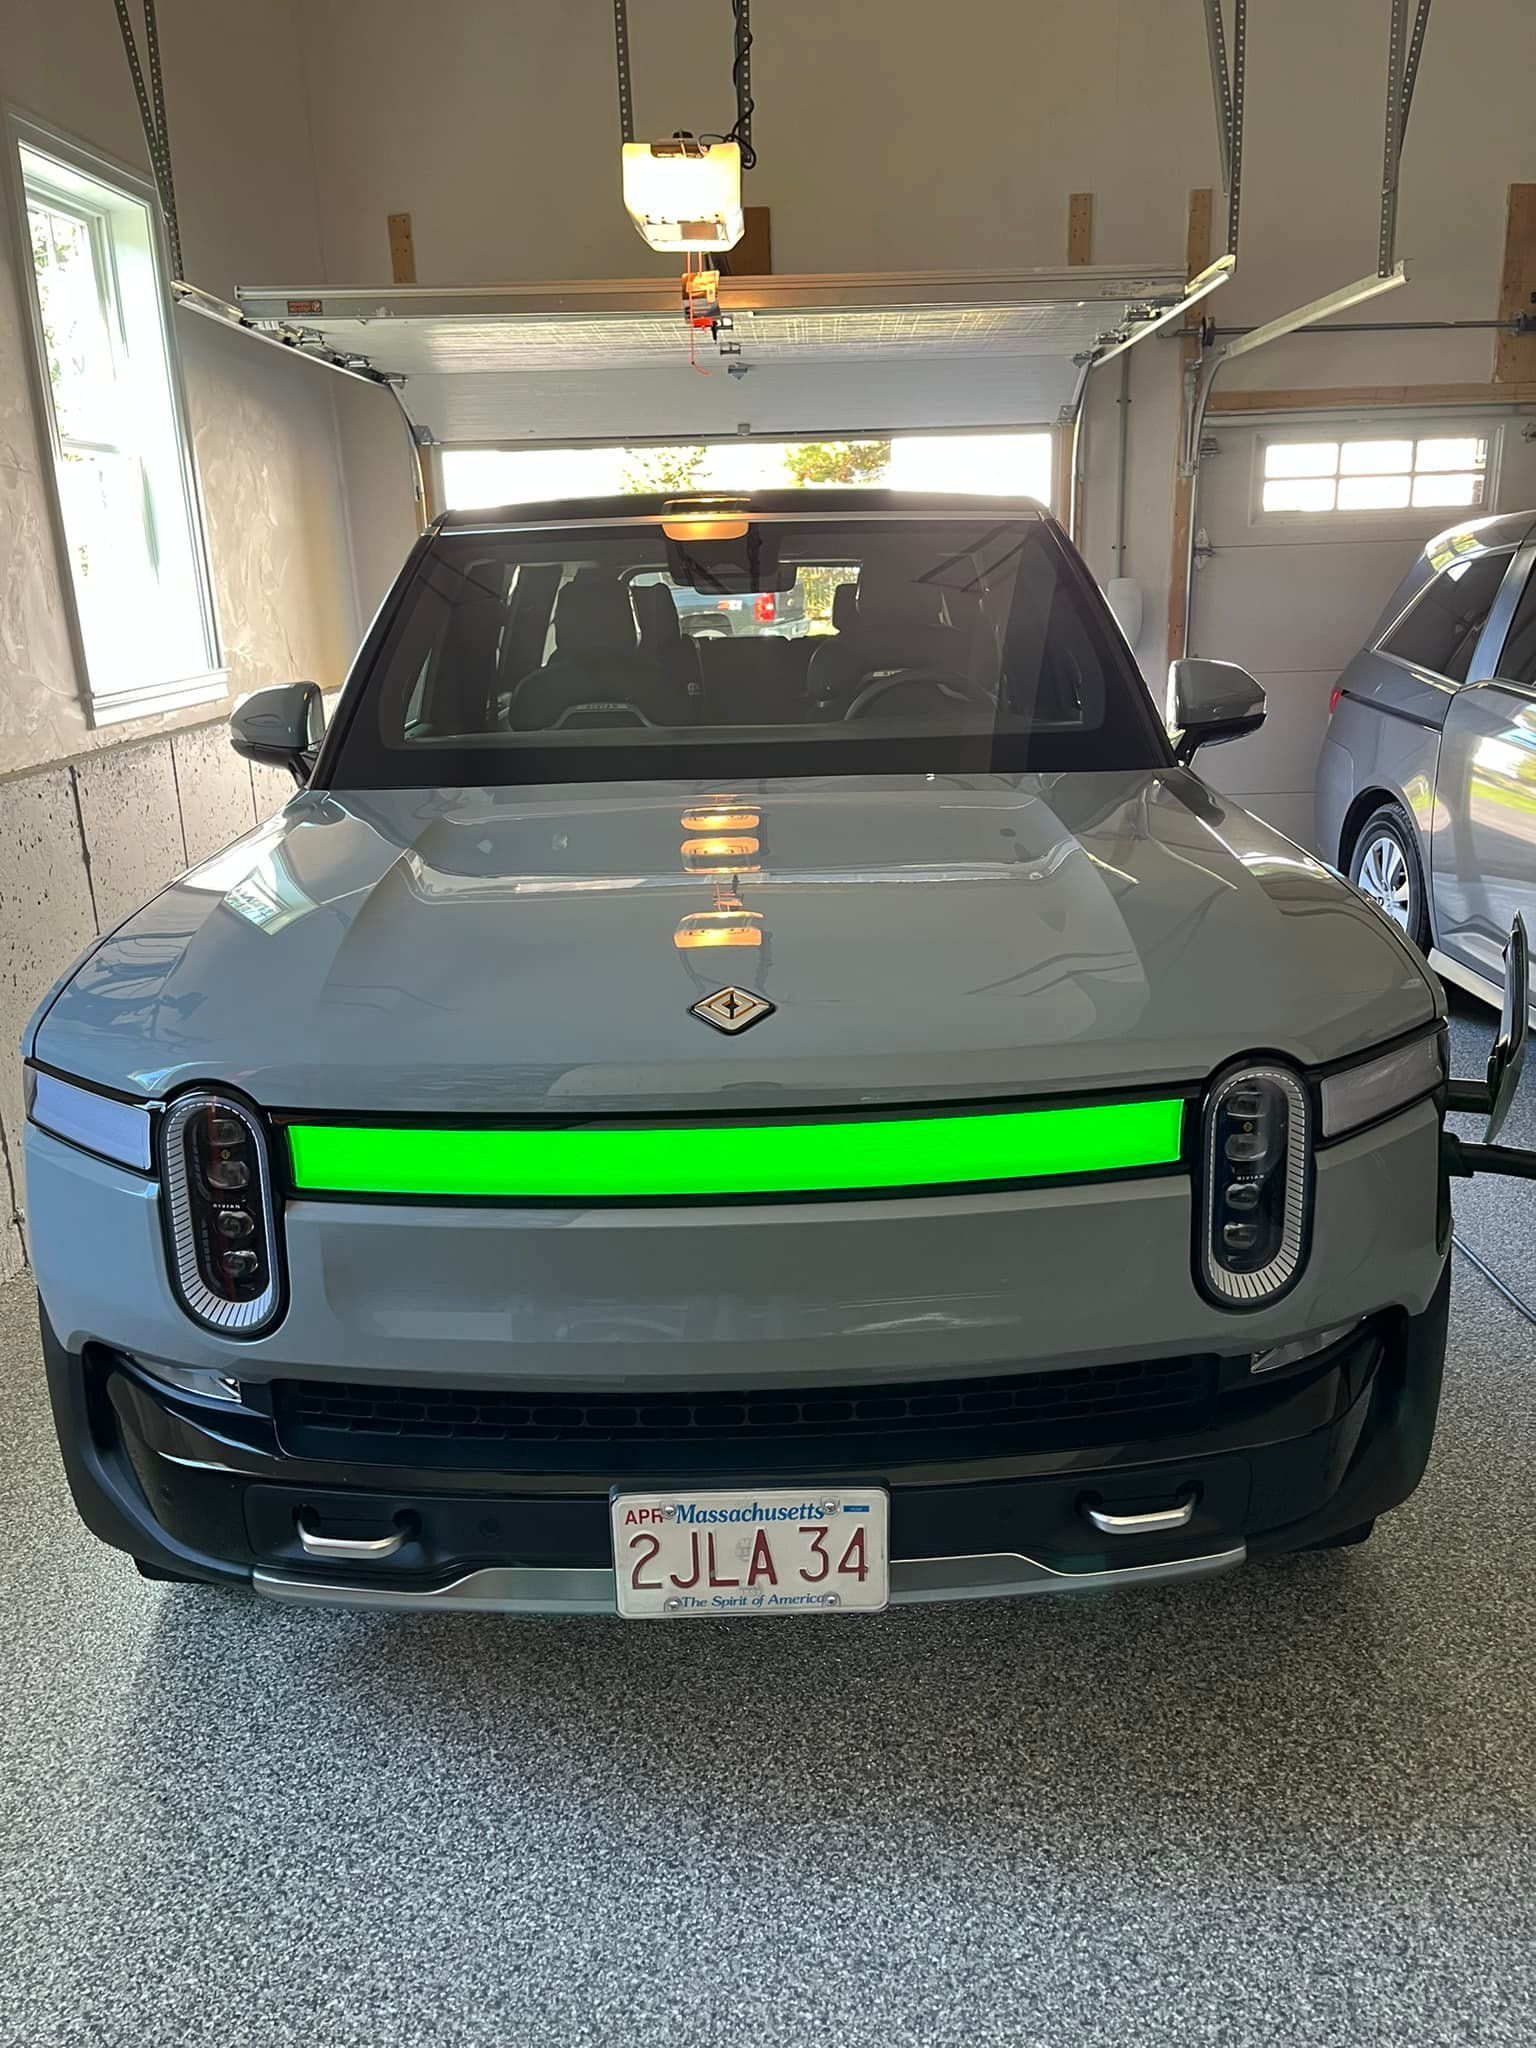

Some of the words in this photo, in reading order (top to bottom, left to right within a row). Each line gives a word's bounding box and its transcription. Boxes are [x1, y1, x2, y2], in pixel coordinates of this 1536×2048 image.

[625, 1508, 663, 1525] APR
[676, 1502, 825, 1524] Massachusetts
[681, 1596, 707, 1608] The
[711, 1595, 746, 1609] Spirit
[751, 1594, 765, 1608] of
[767, 1593, 824, 1605] America
